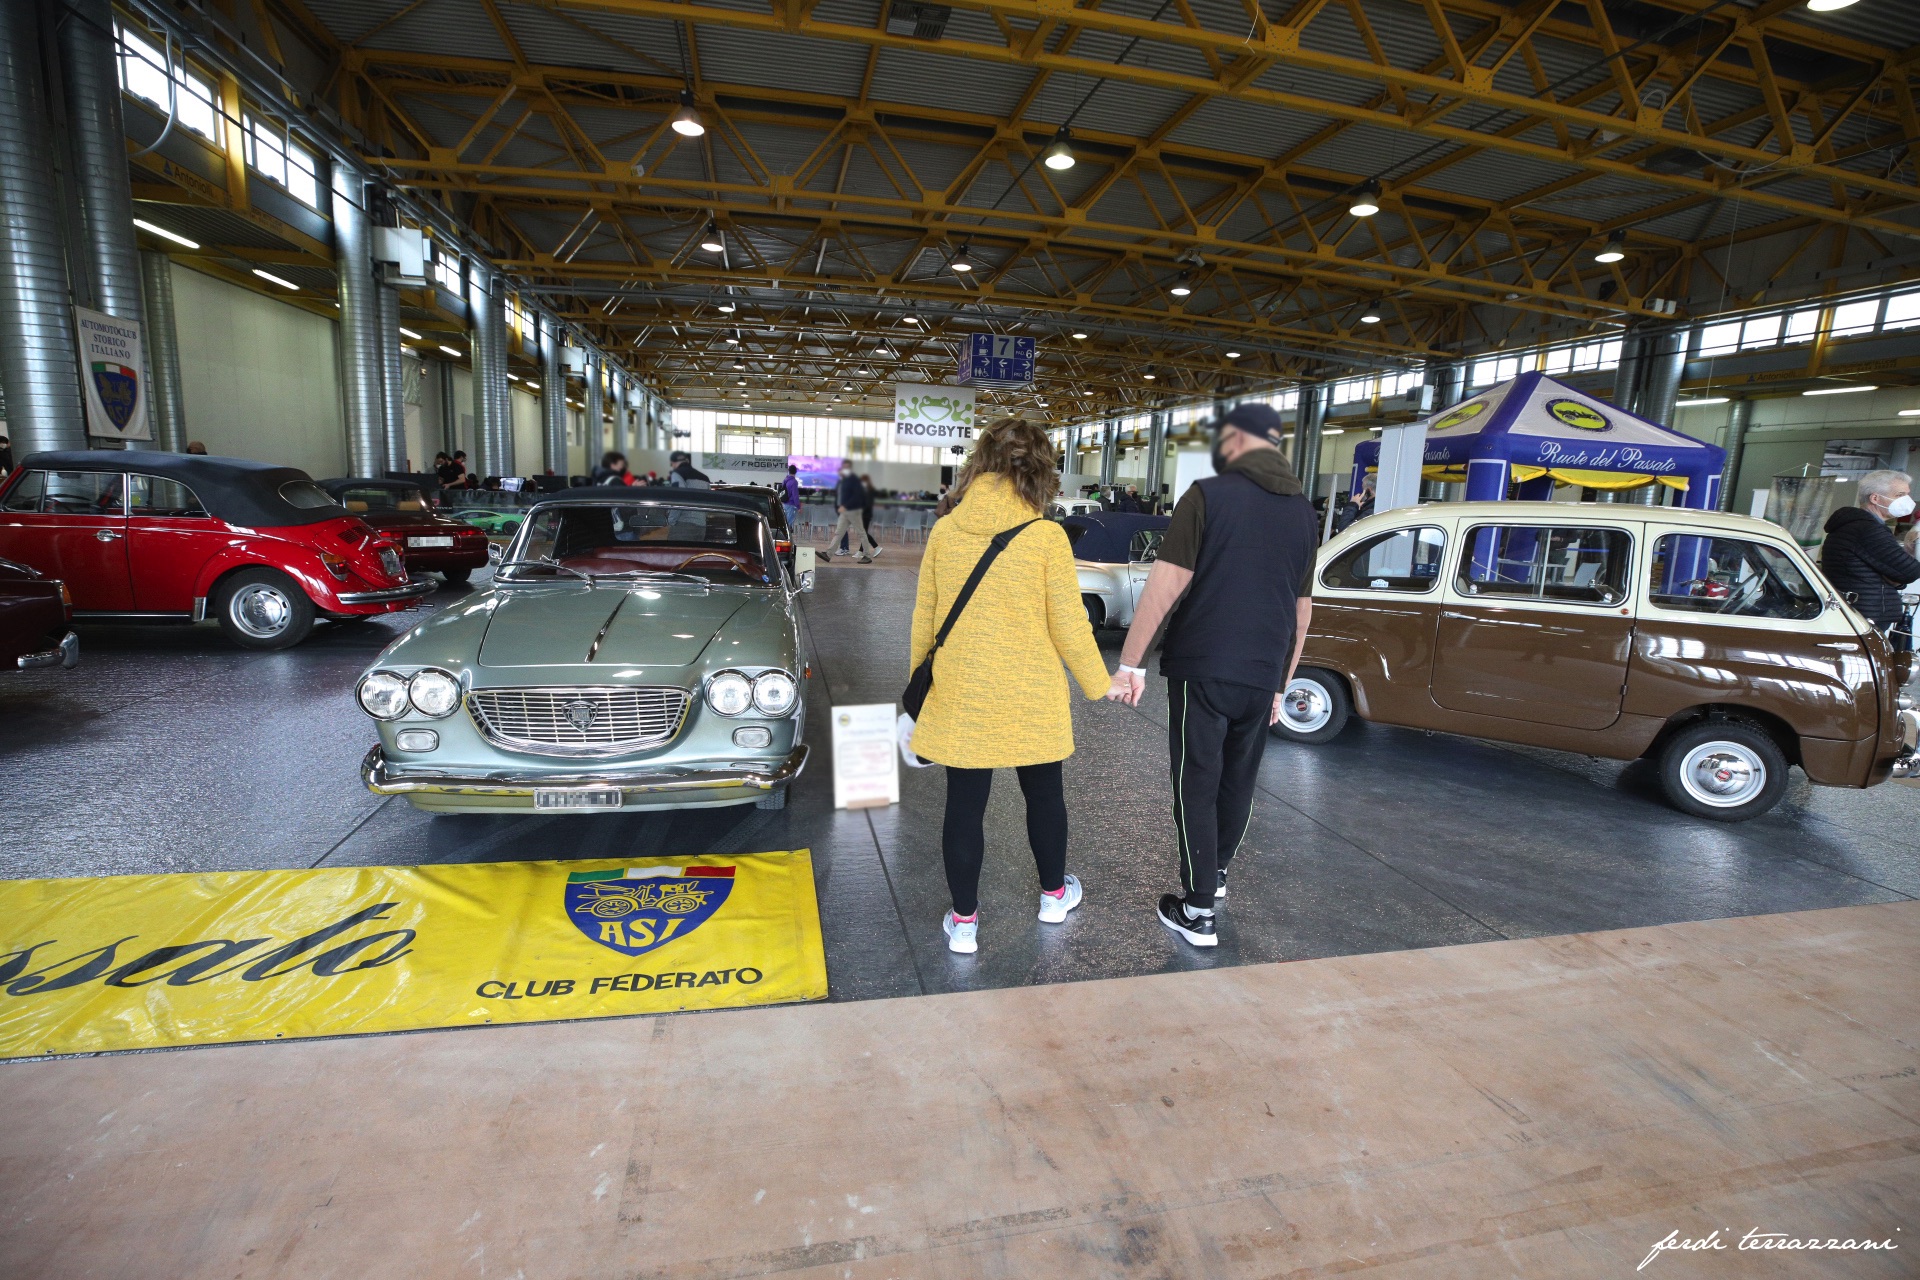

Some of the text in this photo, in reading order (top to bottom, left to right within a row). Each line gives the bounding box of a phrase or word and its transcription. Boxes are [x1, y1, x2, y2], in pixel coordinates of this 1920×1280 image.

[80, 319, 138, 340] AUTOMOTOCLUB
[93, 333, 126, 348] STORICO
[998, 337, 1010, 356] 7
[91, 343, 131, 359] ITALIANO
[1026, 349, 1033, 359] 6
[1024, 370, 1032, 381] 8
[897, 422, 971, 438] FROGBYTE
[1537, 440, 1677, 472] Ruote del Passato
[597, 918, 686, 948] ASI
[476, 967, 764, 1000] CLUB FEDERATO
